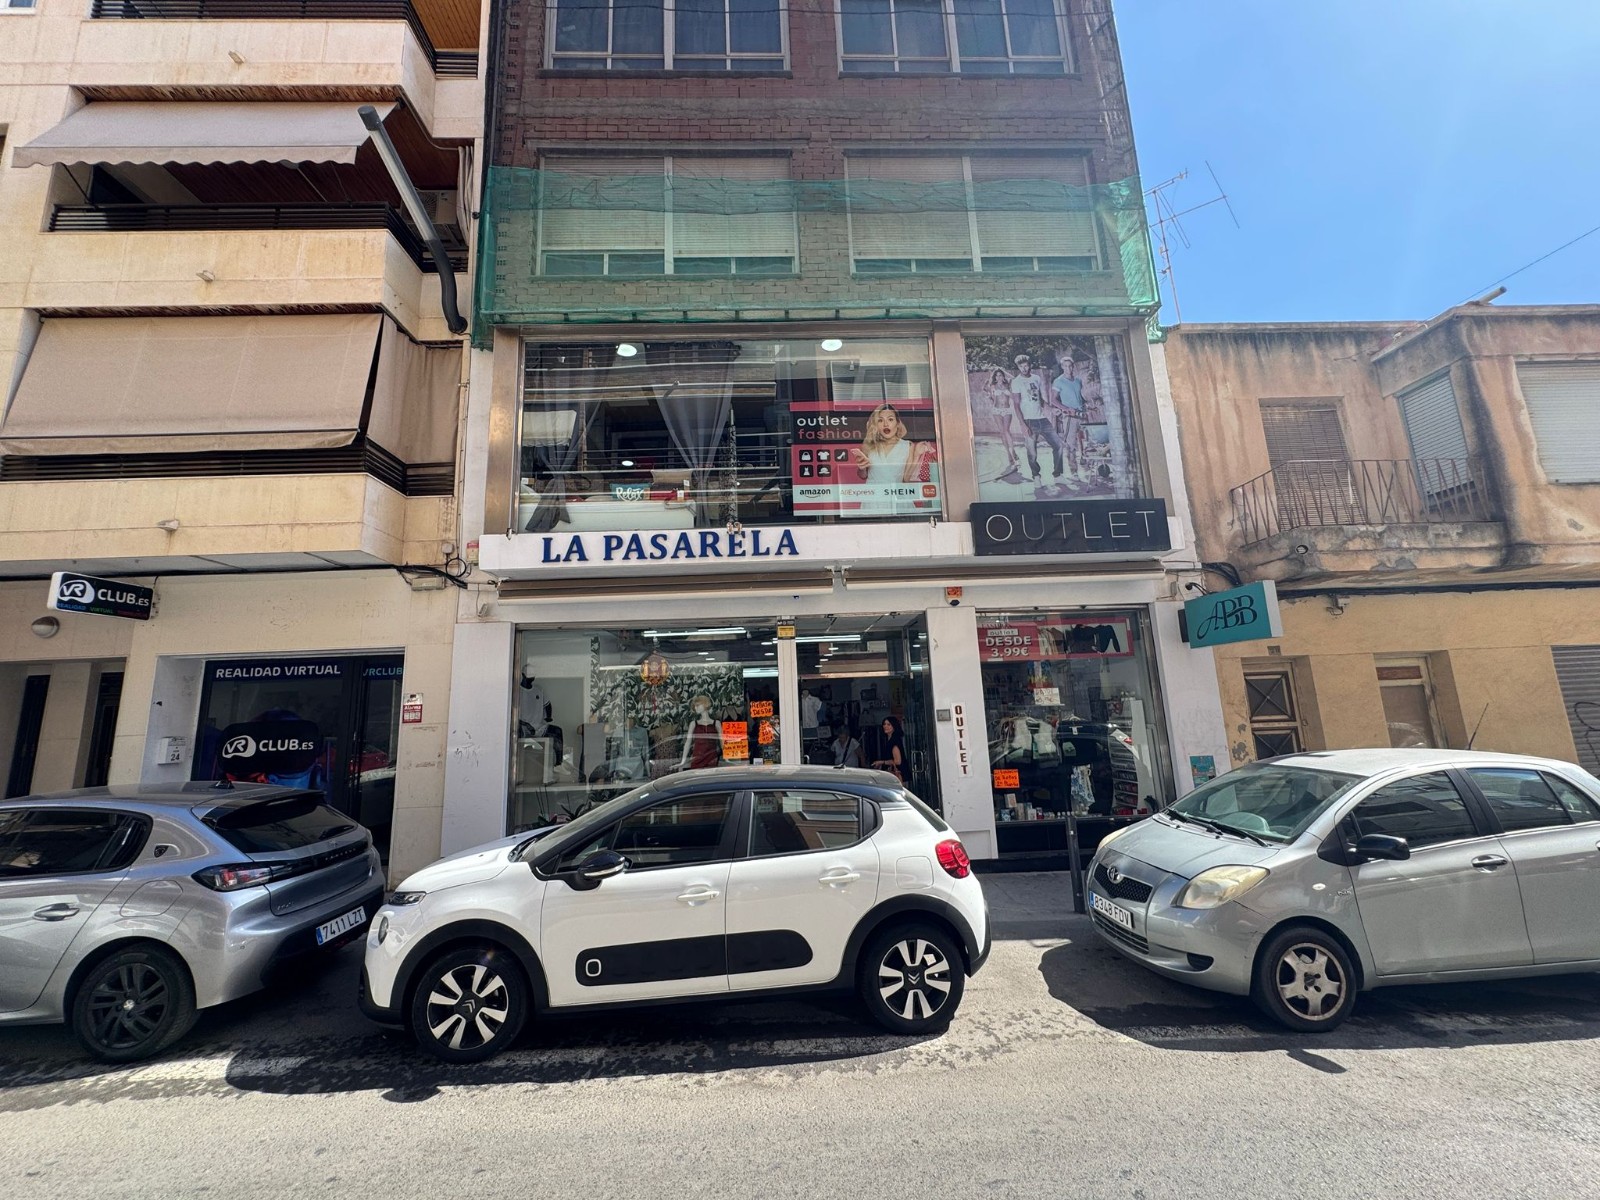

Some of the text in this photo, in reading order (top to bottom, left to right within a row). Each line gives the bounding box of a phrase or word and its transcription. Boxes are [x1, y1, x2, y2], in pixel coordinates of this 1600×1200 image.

[797, 415, 848, 427] outlet
[798, 428, 862, 440] fashion
[616, 486, 644, 501] Relax
[799, 488, 831, 496] amazon
[884, 488, 915, 496] SHEIN
[986, 510, 1156, 542] OUTLET
[541, 529, 799, 563] LA PASARELA
[62, 583, 85, 597] VR
[1197, 595, 1258, 640] ABB
[985, 635, 1032, 647] DESDE
[991, 647, 1030, 658] 3.99€
[216, 665, 341, 679] REALIDAD VIRTUAL
[226, 739, 247, 754] VR
[955, 705, 968, 775] OUTLET
[170, 753, 180, 762] 24
[1095, 895, 1129, 926] 8348 FDV
[322, 908, 364, 940] 7411 LZT
